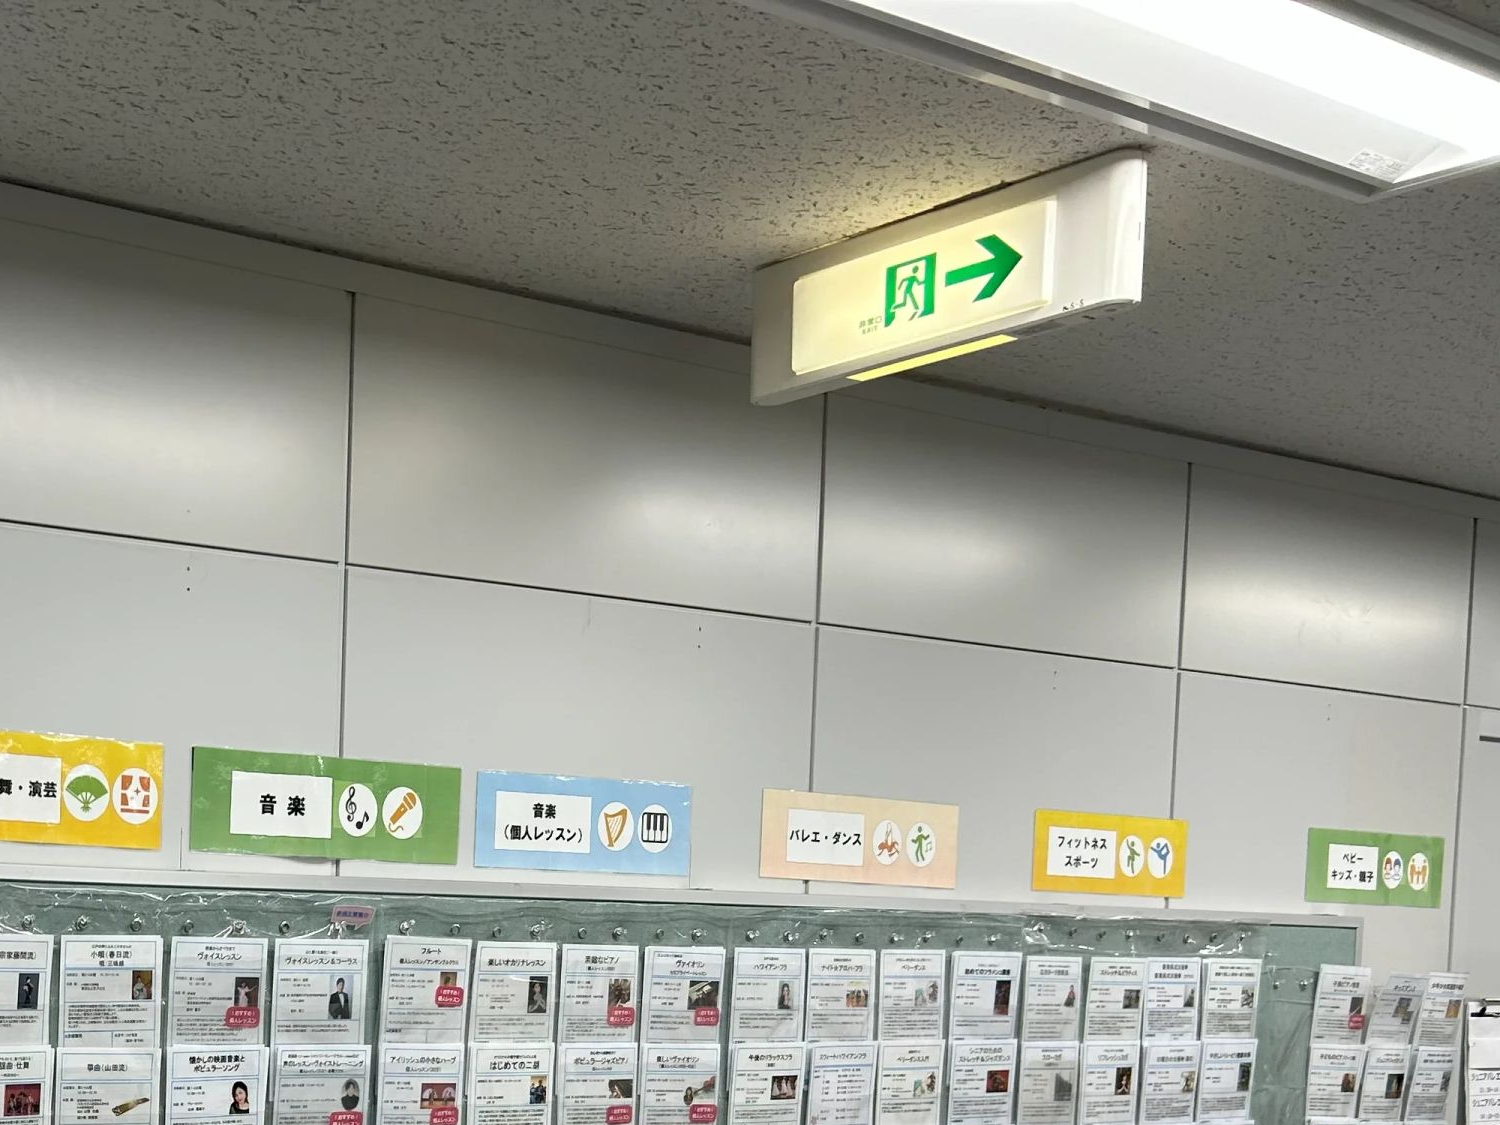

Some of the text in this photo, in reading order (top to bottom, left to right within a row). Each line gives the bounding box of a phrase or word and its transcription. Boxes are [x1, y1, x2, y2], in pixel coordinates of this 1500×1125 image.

[260, 793, 306, 817] 音楽
[532, 802, 557, 820] 音楽
[504, 824, 584, 845] （個人レッスン）
[789, 828, 863, 846] バレエ・ダンス
[1057, 835, 1108, 851] フィットネス
[1065, 854, 1099, 870] スポーツ
[1331, 869, 1374, 883] キッズ・親子
[197, 952, 242, 961] ヴォイスレッスン
[189, 1055, 245, 1064] 懐かしの映画音楽と
[490, 1060, 540, 1070] はじめての二胡
[193, 1064, 240, 1073] ポピュラーソング
